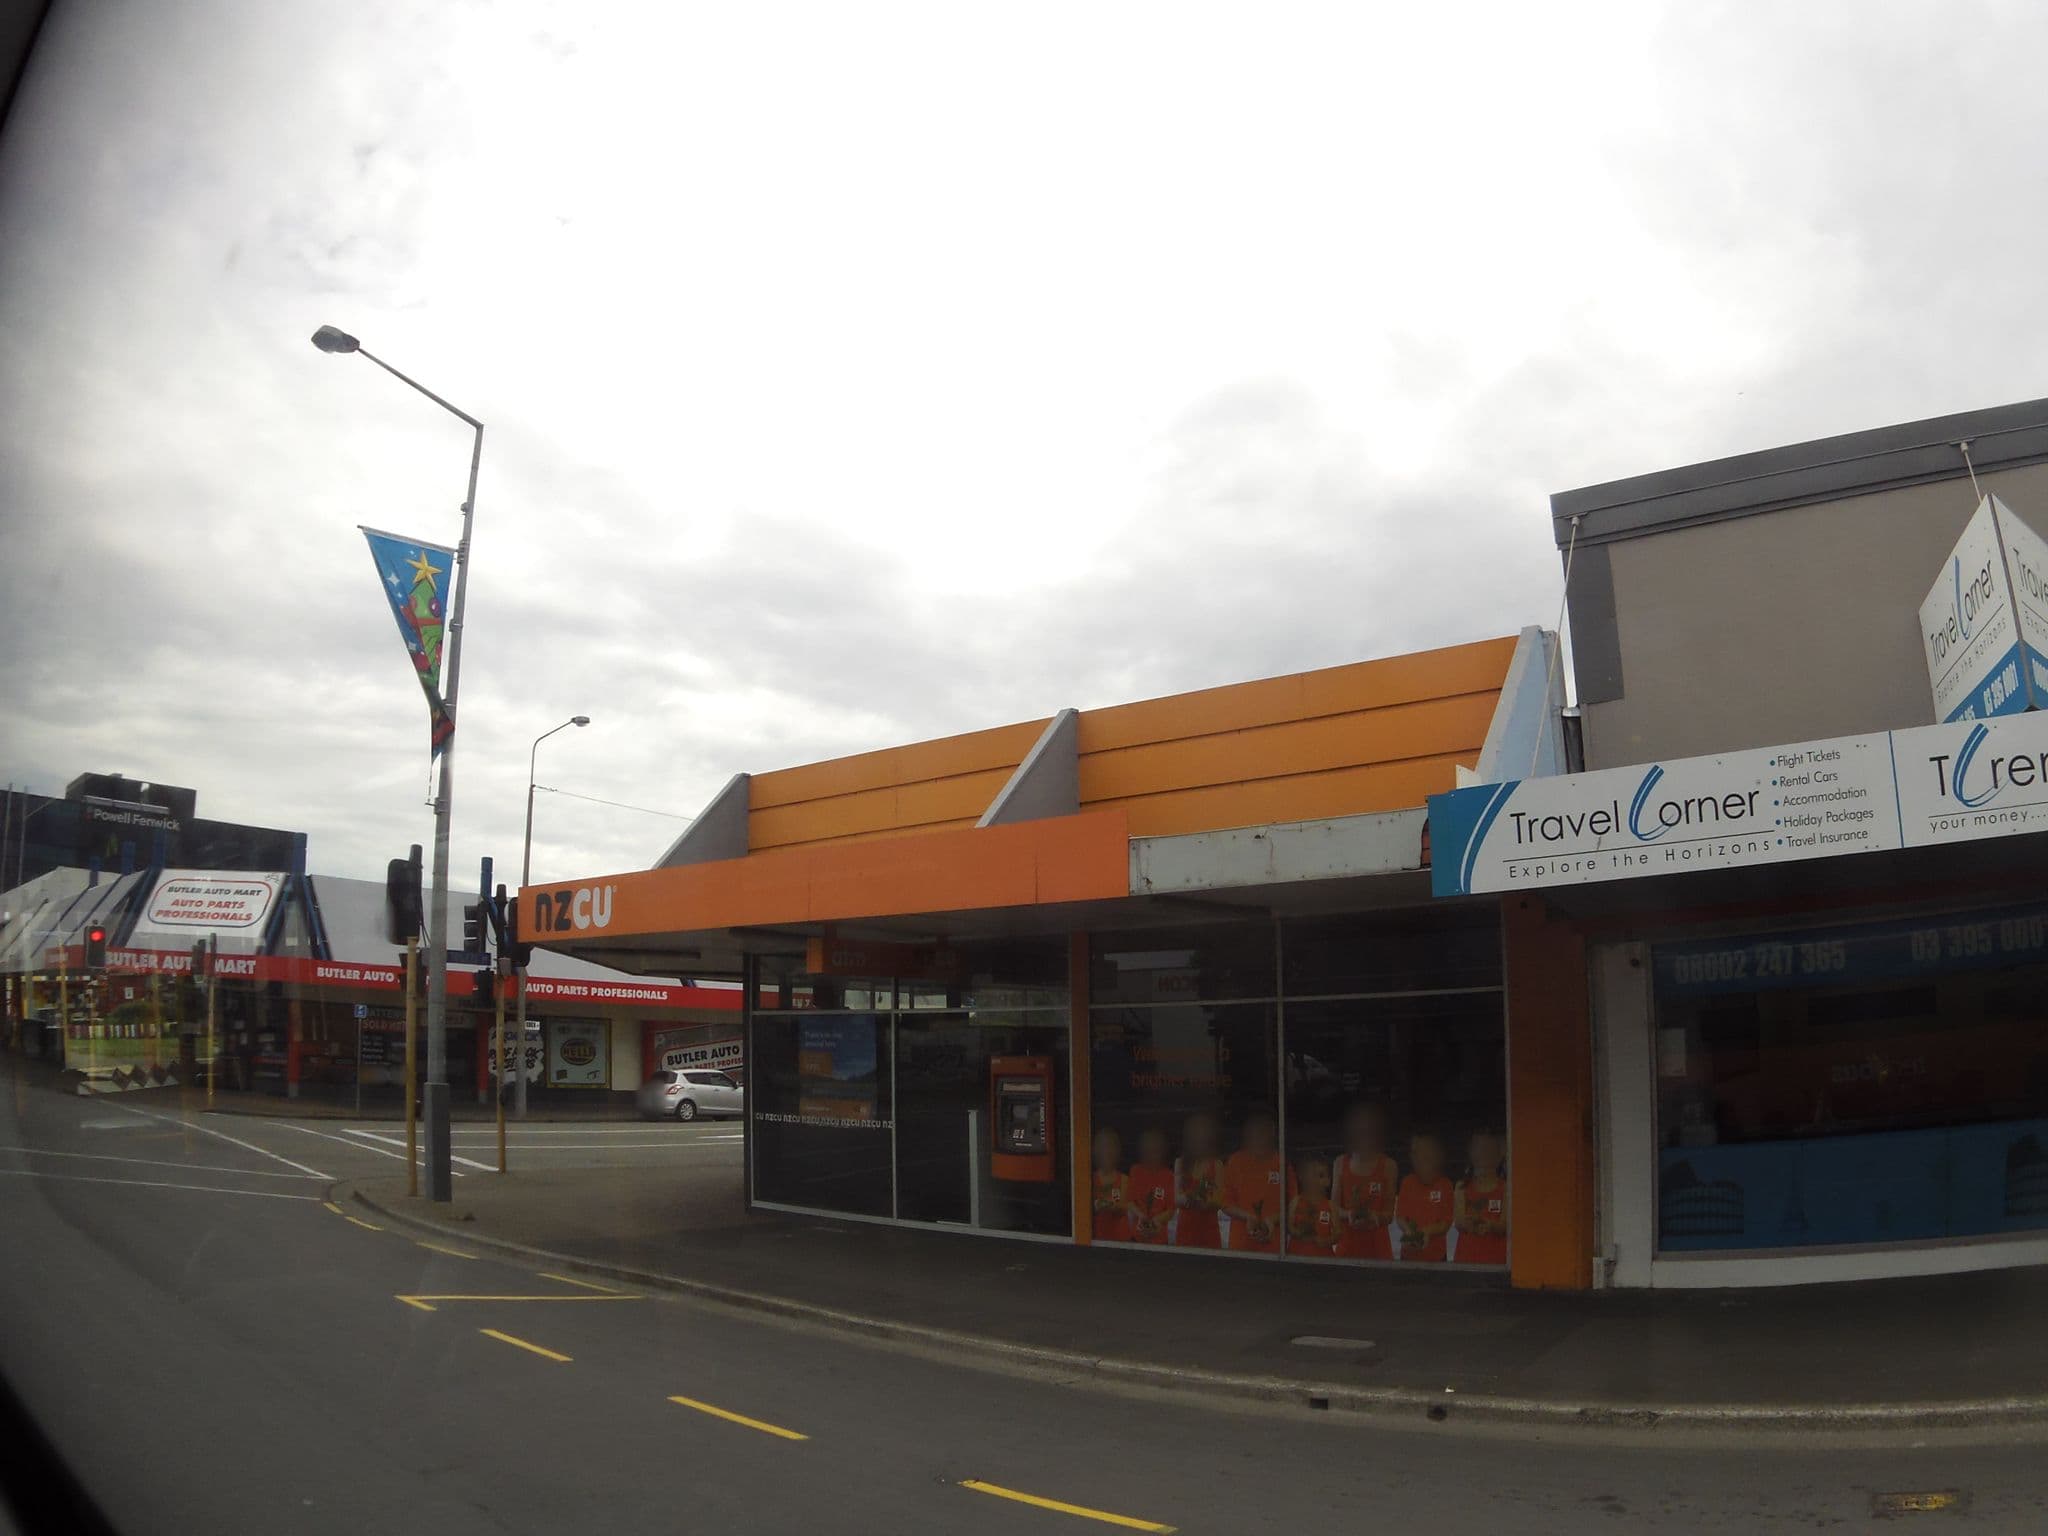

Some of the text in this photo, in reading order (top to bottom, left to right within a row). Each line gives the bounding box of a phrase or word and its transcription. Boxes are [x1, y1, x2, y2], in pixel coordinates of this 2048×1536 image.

[1930, 602, 1959, 667] Travel
[1777, 750, 1841, 769] Flight Tickets
[1779, 771, 1839, 788] Rental Cars
[1509, 764, 1761, 844] Travel Corner
[1782, 787, 1868, 807] Accommodation
[93, 808, 180, 832] Powell Fenwick
[1783, 808, 1875, 828] Holiday Packages
[1930, 816, 1966, 834] your
[1786, 829, 1869, 848] Travel Insurance
[1509, 839, 1770, 880] Explore the Horizons
[168, 886, 262, 897] BUTLER AUTO MART
[171, 899, 246, 909] AUTO PARTS
[155, 909, 253, 922] PROFESSIONALS
[104, 951, 159, 970] BUTLER
[162, 955, 193, 971] AUT
[317, 966, 361, 981] BUTLER
[363, 970, 395, 983] AUTO
[526, 982, 669, 1001] AUTO PARTS PROFESSIONALS
[667, 1045, 740, 1066] BUTLER AUTO
